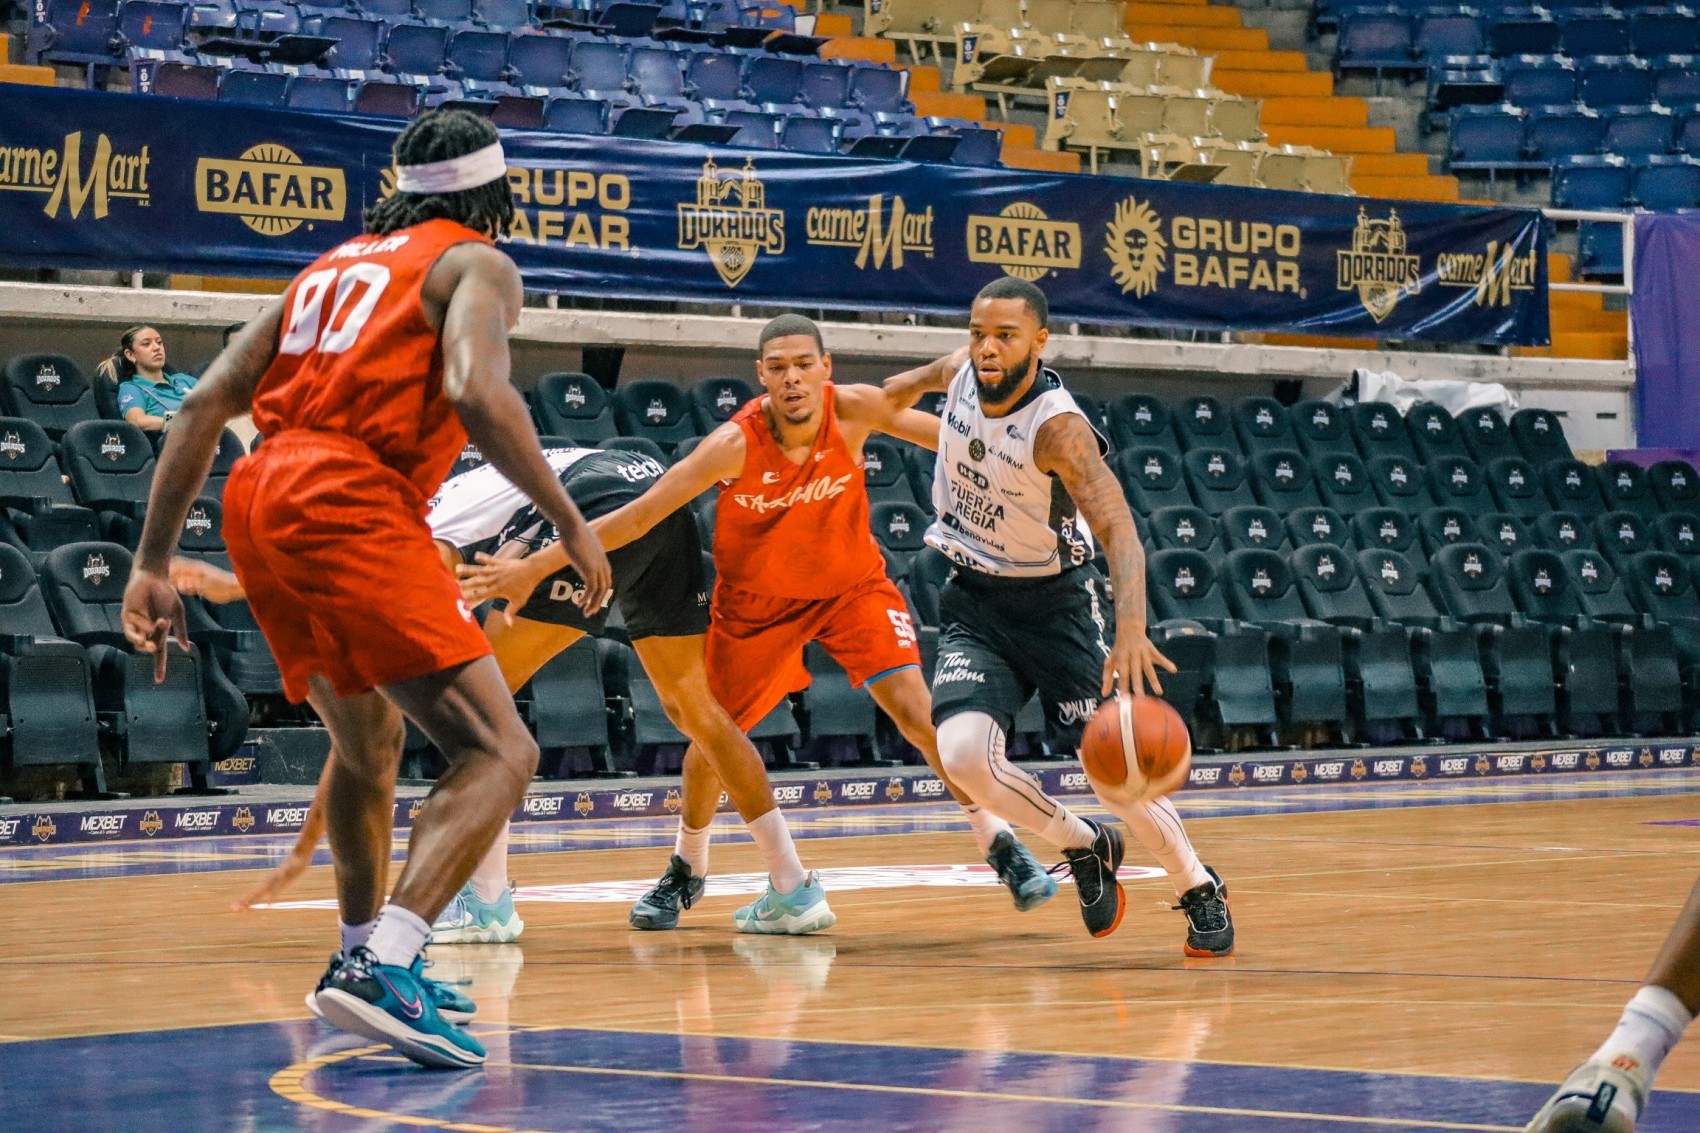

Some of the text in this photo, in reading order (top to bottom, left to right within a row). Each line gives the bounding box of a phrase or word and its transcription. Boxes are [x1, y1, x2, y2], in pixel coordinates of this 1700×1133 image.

[0, 130, 149, 219] arneMart
[207, 168, 334, 210] BAFAR
[506, 167, 630, 211] RUPO
[502, 208, 630, 251] AFAR
[1171, 216, 1301, 257] GRUPO
[975, 224, 1072, 259] BAFAR
[1174, 253, 1300, 293] BAFAR
[1339, 252, 1421, 292] DORADOS
[947, 411, 971, 438] Mobil
[951, 479, 1005, 520] FUERZA
[955, 501, 996, 532] REGIA
[944, 651, 972, 668] Tim
[214, 757, 256, 771] MEXBET
[1190, 768, 1222, 782] MEXBET
[1253, 765, 1285, 779] MEXBET
[774, 786, 805, 800] EXBET
[841, 781, 878, 796] MEXBET
[524, 797, 564, 812] MEXBET
[614, 793, 653, 807] MEXBET
[81, 815, 127, 831] MEXBET
[175, 811, 221, 827] MEXBET
[267, 808, 310, 823] MEXBET
